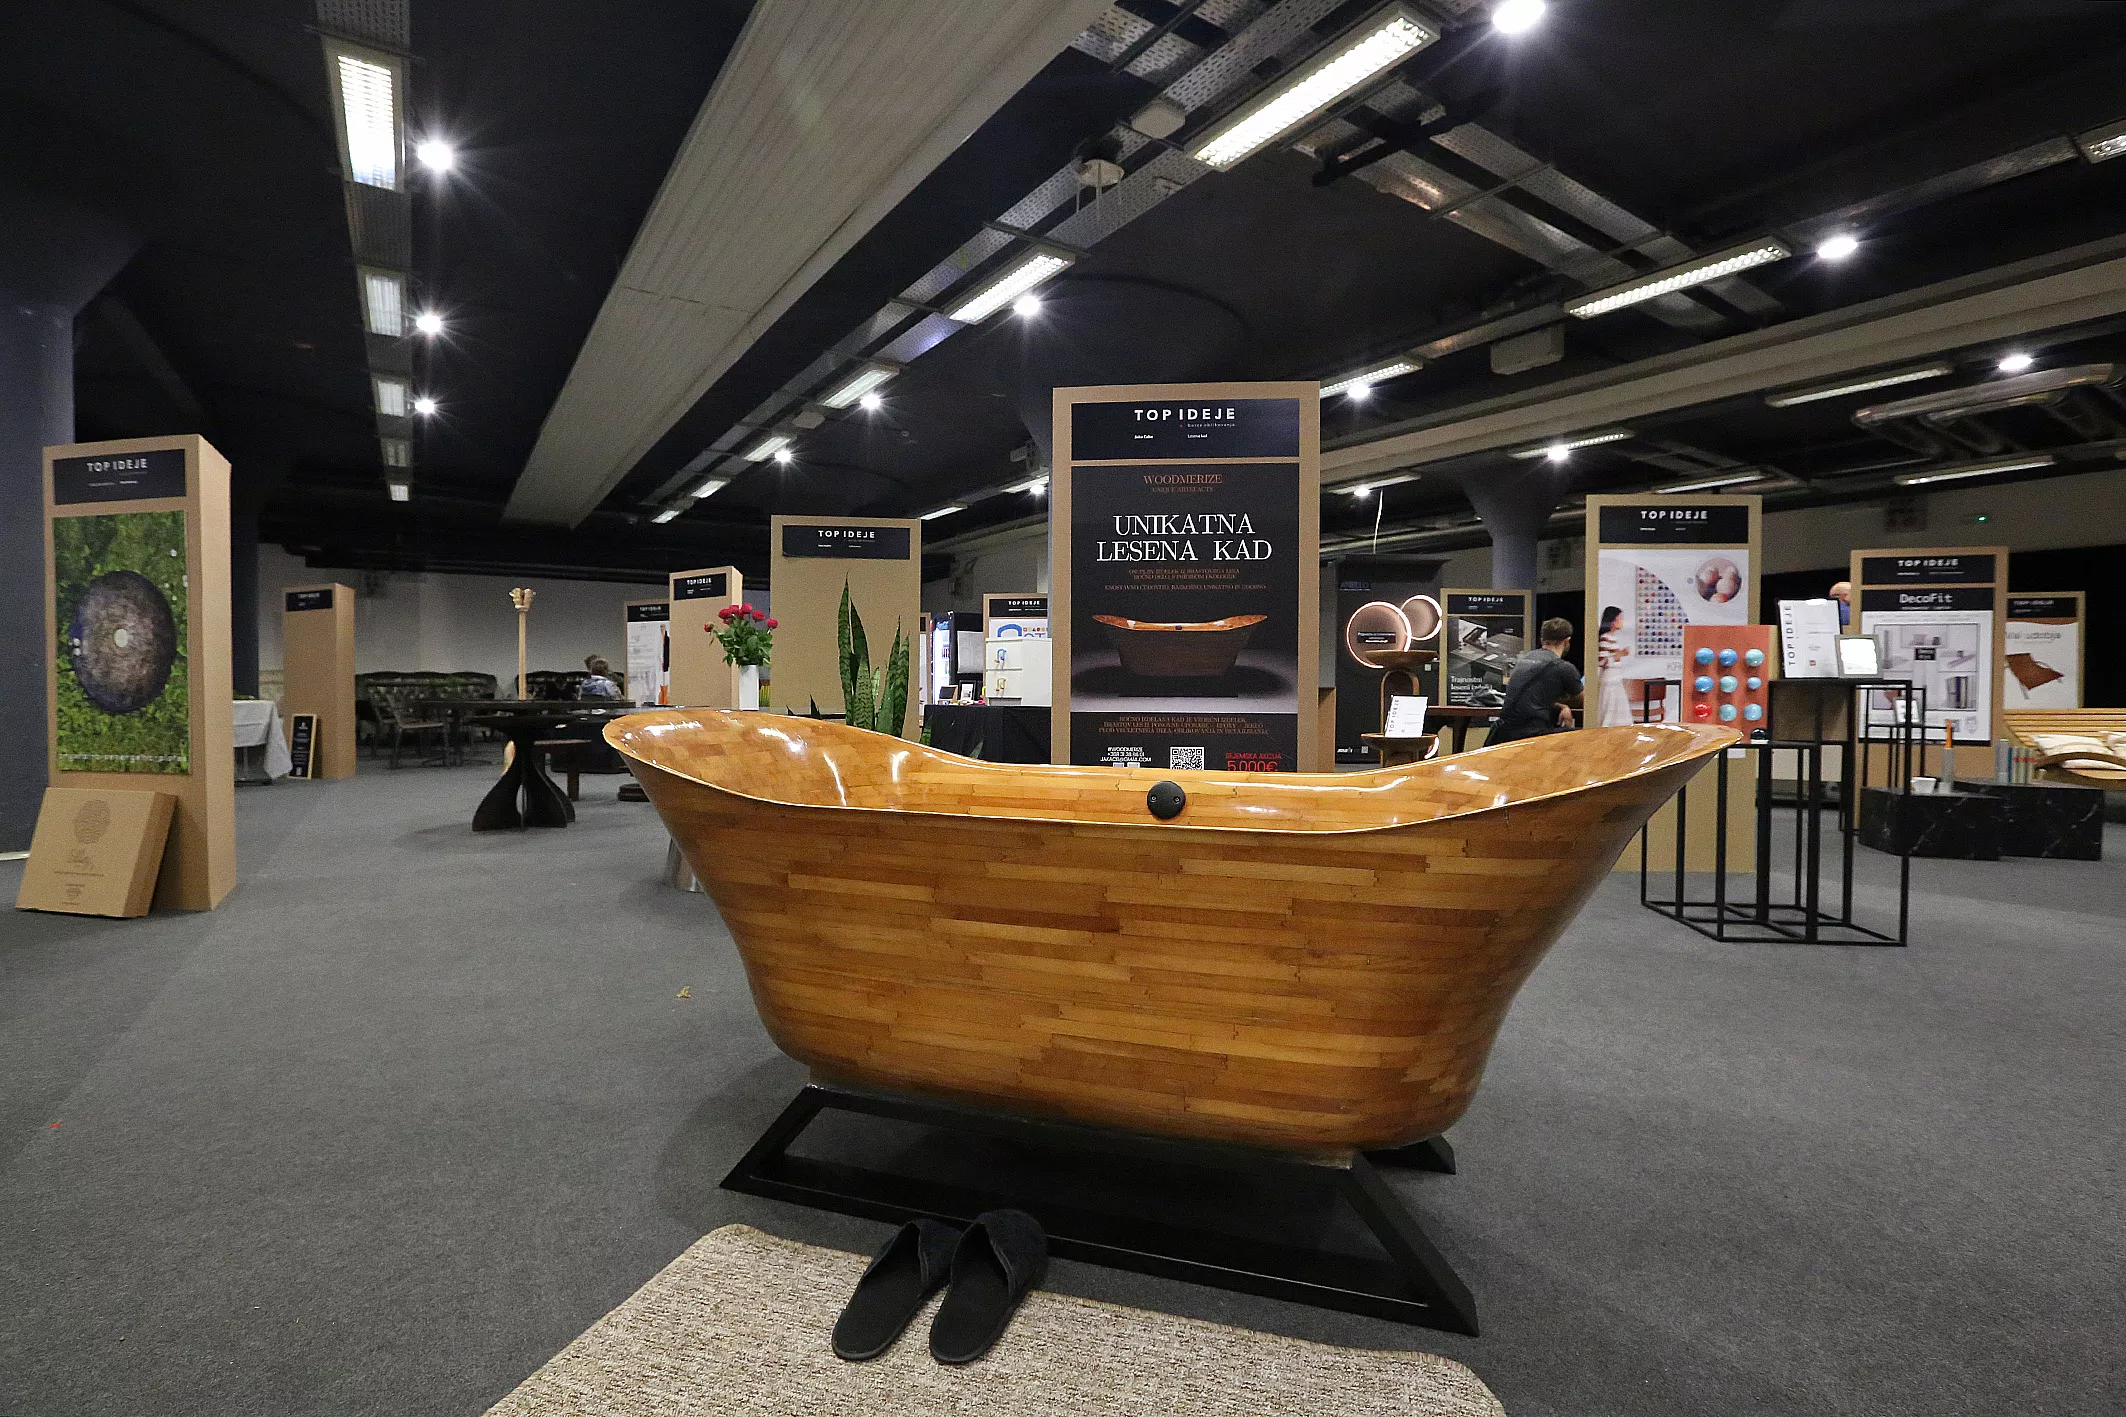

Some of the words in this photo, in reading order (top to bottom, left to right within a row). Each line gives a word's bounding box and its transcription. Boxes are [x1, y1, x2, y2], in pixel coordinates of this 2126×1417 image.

[1134, 409, 1172, 421] TOP
[1179, 408, 1235, 421] IDEJE
[86, 461, 111, 472] TOP
[112, 458, 148, 471] IDEJE
[1143, 475, 1223, 484] WOODMERIZE
[1640, 510, 1667, 520] TOP
[1669, 510, 1708, 520] IDEJE
[1113, 513, 1256, 536] UNIKATNA
[817, 530, 840, 538] TOP
[843, 530, 875, 539] IDEJE
[1096, 540, 1199, 562] LESENA
[1212, 539, 1273, 561] KAD
[1897, 559, 1922, 567] TOP
[1923, 558, 1959, 567] IDEJE
[1899, 593, 1953, 604] DecoFit
